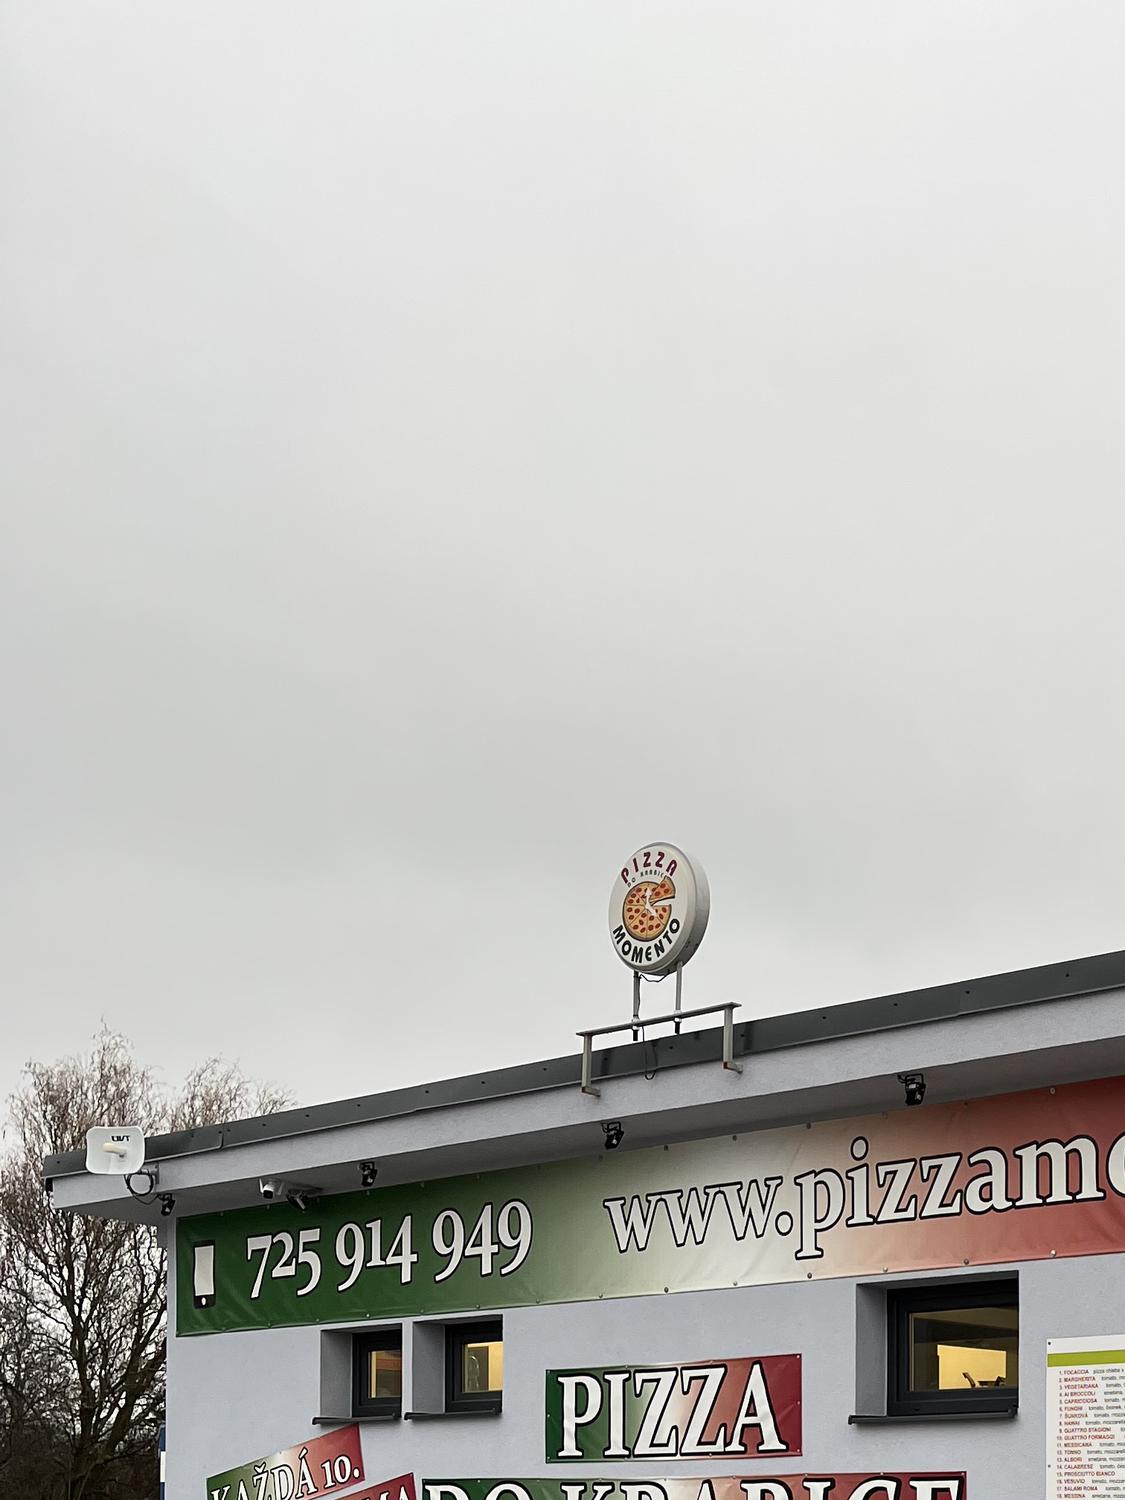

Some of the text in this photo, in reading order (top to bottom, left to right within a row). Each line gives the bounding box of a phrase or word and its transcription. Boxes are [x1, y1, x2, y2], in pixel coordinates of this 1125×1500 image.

[621, 851, 678, 884] PIZZA
[613, 918, 680, 963] MOMENTO
[246, 1200, 534, 1299] 725 914 949
[556, 1360, 789, 1460] PIZZA
[320, 1454, 361, 1490] 10.
